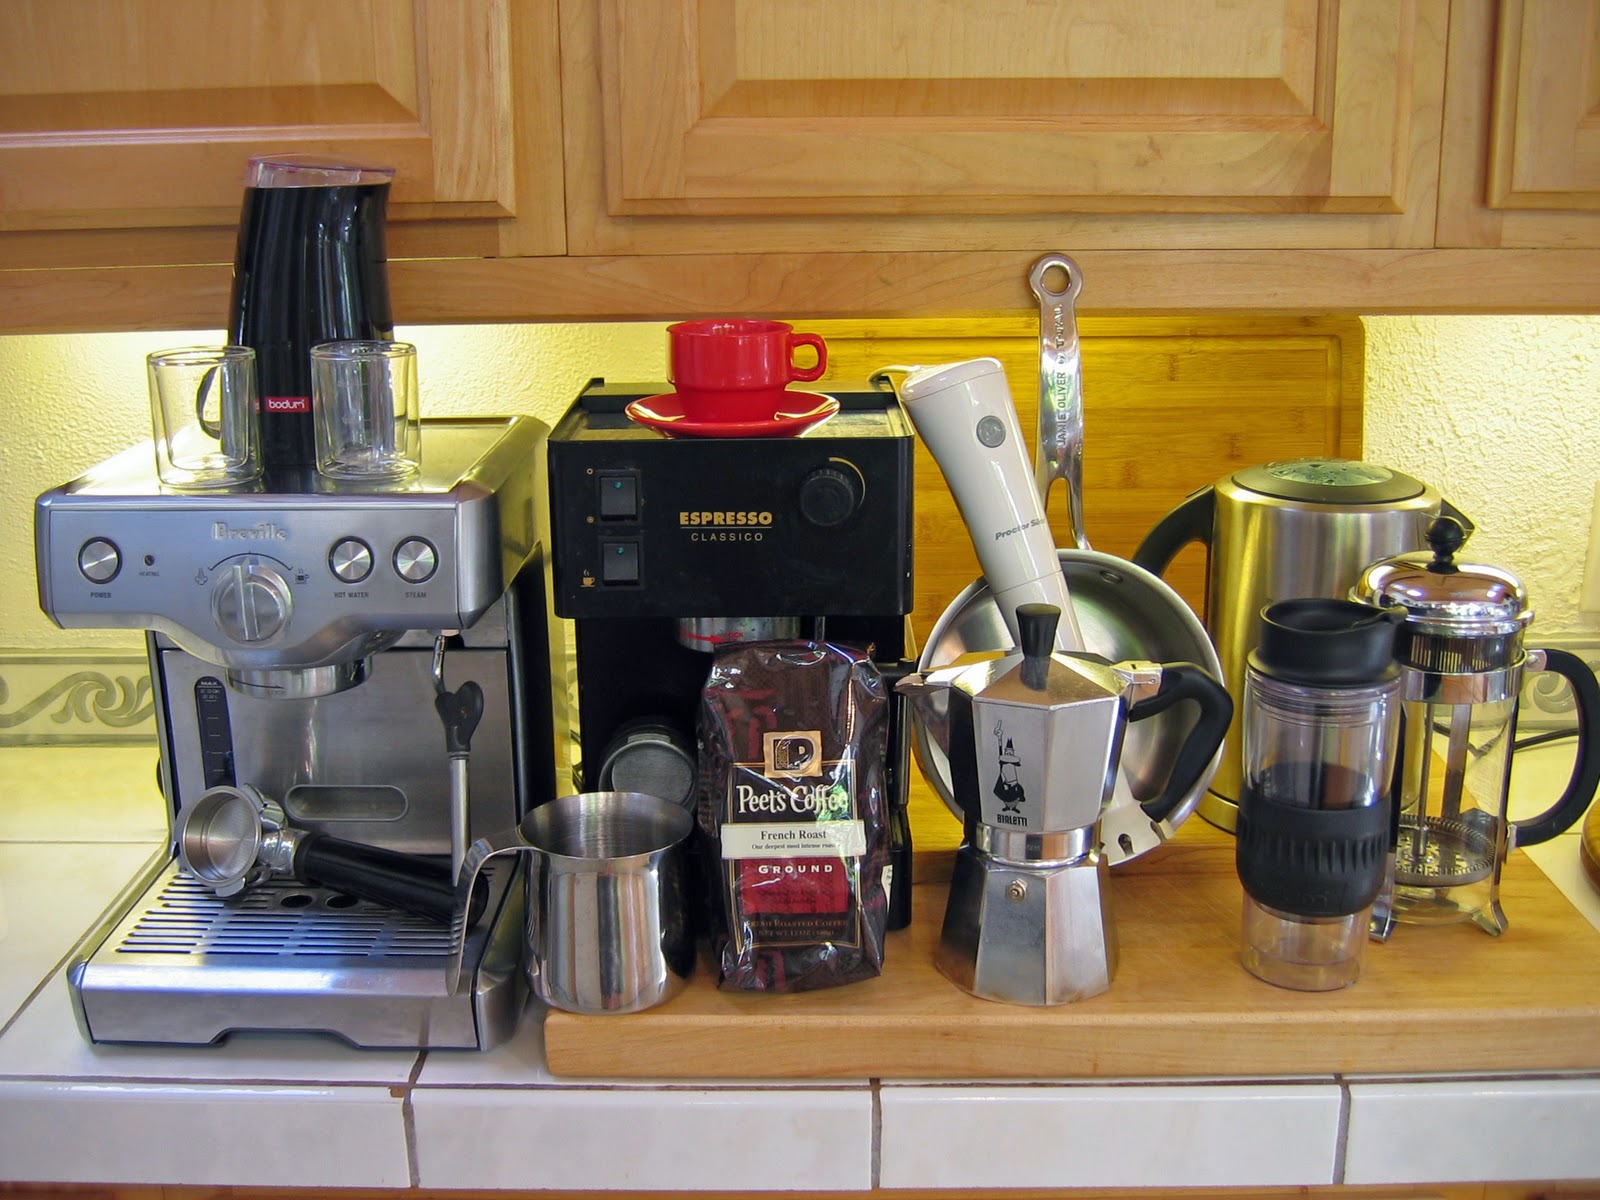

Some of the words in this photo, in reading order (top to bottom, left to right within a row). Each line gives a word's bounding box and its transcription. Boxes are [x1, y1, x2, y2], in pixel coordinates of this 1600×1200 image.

[1057, 370, 1067, 409] OLIVER
[268, 398, 305, 409] bodum
[1057, 412, 1067, 447] JAMIE
[679, 511, 773, 525] ESPRESSO
[211, 522, 288, 543] Breville
[690, 532, 764, 542] CLASSICO
[995, 523, 1030, 541] Proctor
[90, 591, 112, 599] POWER
[334, 591, 349, 599] HOT
[351, 591, 370, 599] WATER
[404, 591, 427, 599] STEAM
[735, 785, 787, 814] Peet's
[760, 830, 796, 840] French
[798, 830, 827, 839] Roast
[758, 864, 833, 874] GROUND
